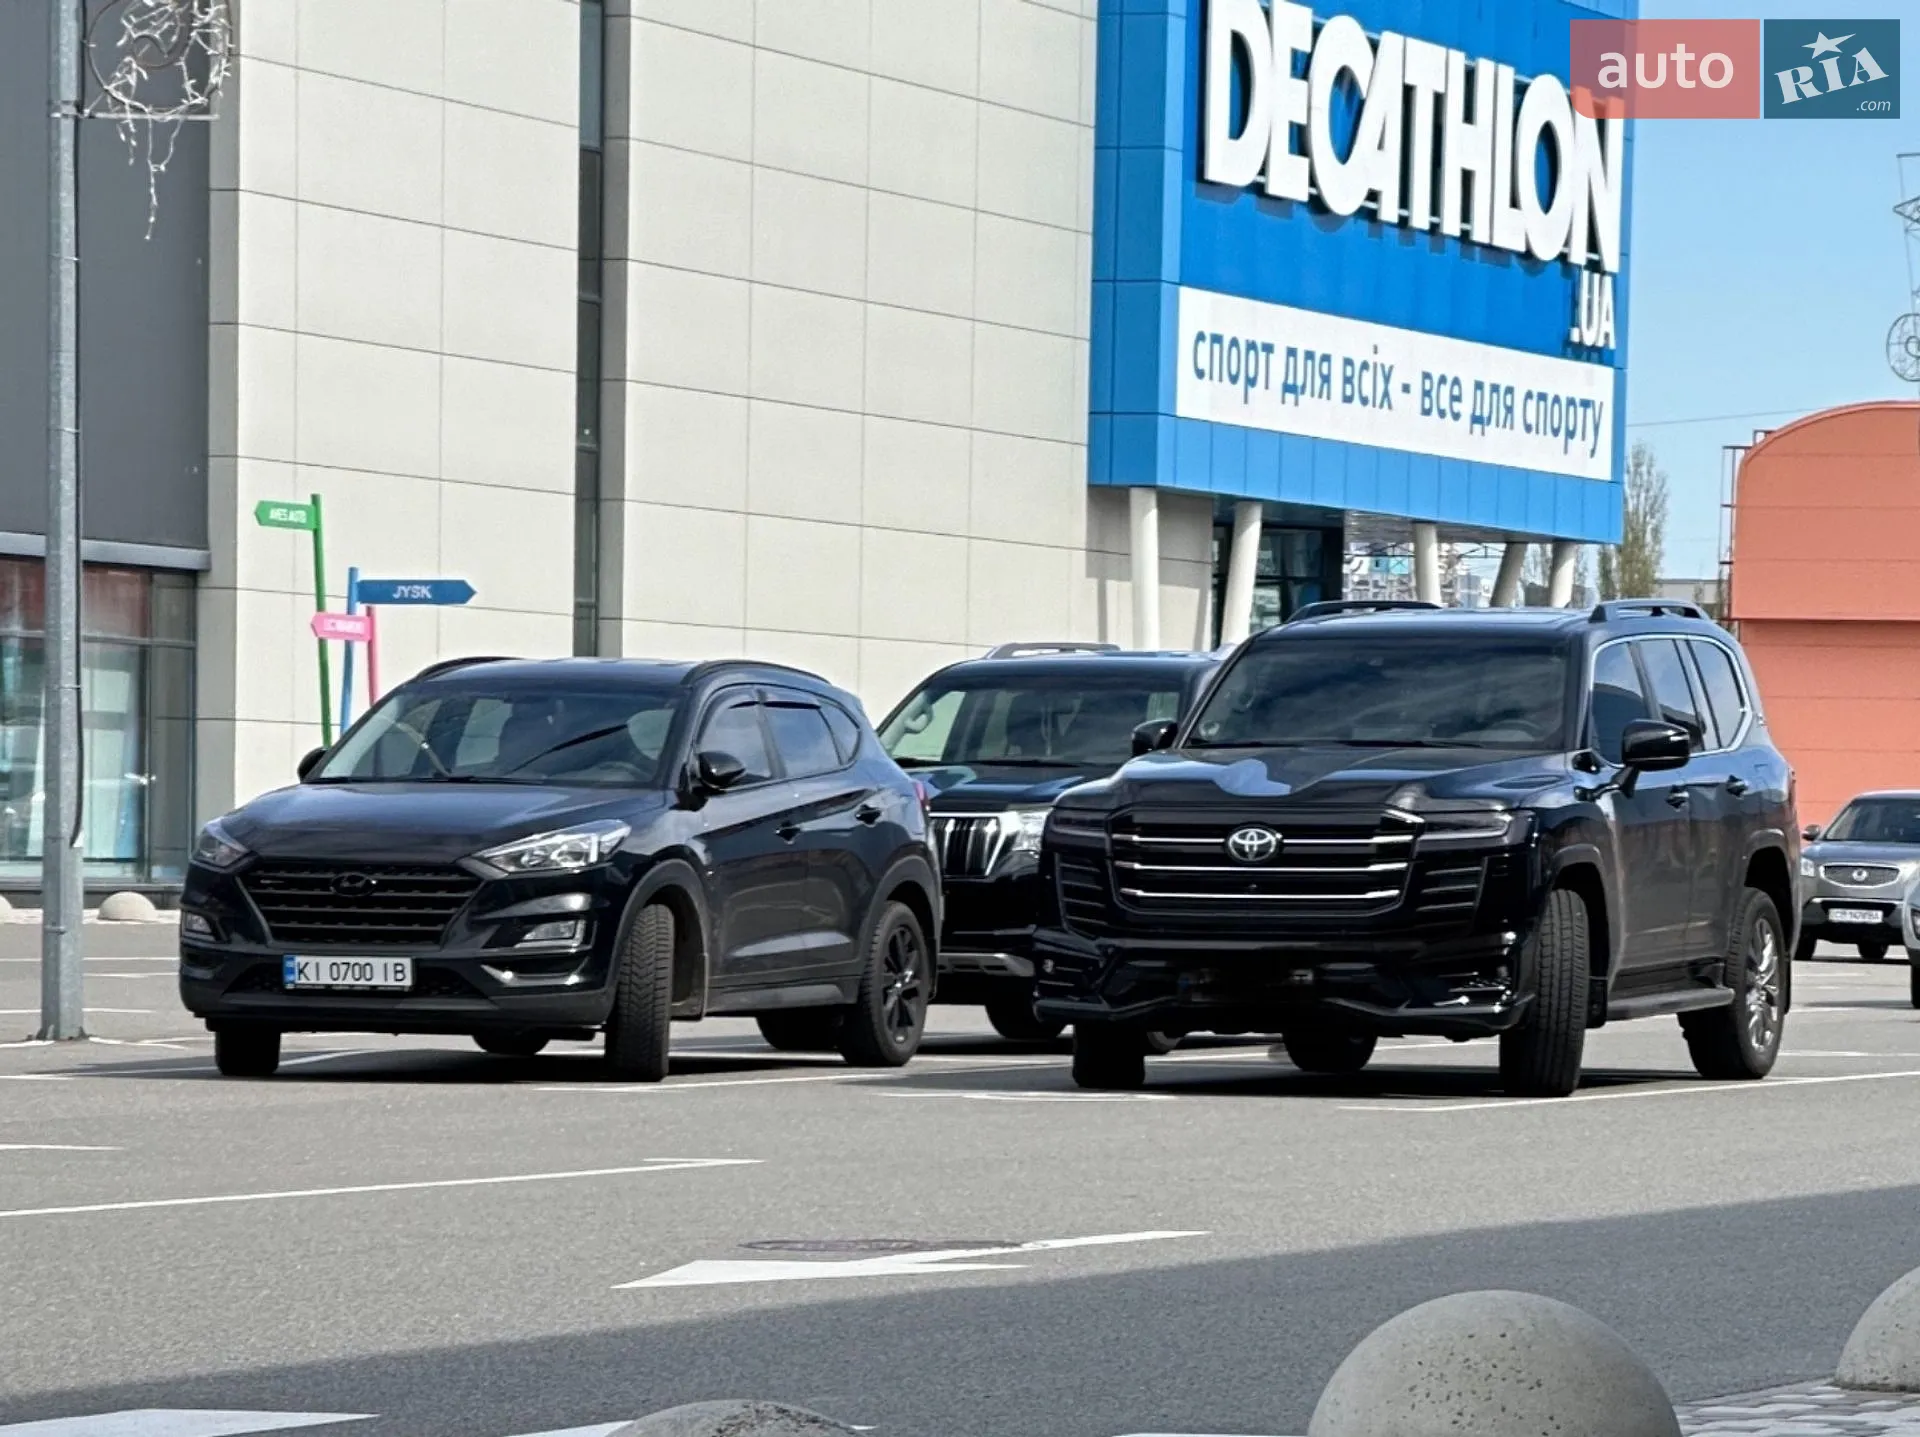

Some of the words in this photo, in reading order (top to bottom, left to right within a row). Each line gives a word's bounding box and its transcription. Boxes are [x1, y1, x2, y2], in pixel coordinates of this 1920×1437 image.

[1204, 0, 1624, 272] DECATHLON
[1570, 269, 1616, 350] .UA
[1193, 330, 1275, 405] спорт
[1281, 346, 1332, 407] для
[1341, 344, 1394, 411] всіх
[1420, 370, 1463, 422] все
[1469, 379, 1515, 437] для
[1522, 389, 1604, 459] спорту
[392, 584, 433, 600] JYSK
[329, 961, 374, 982] 0700
